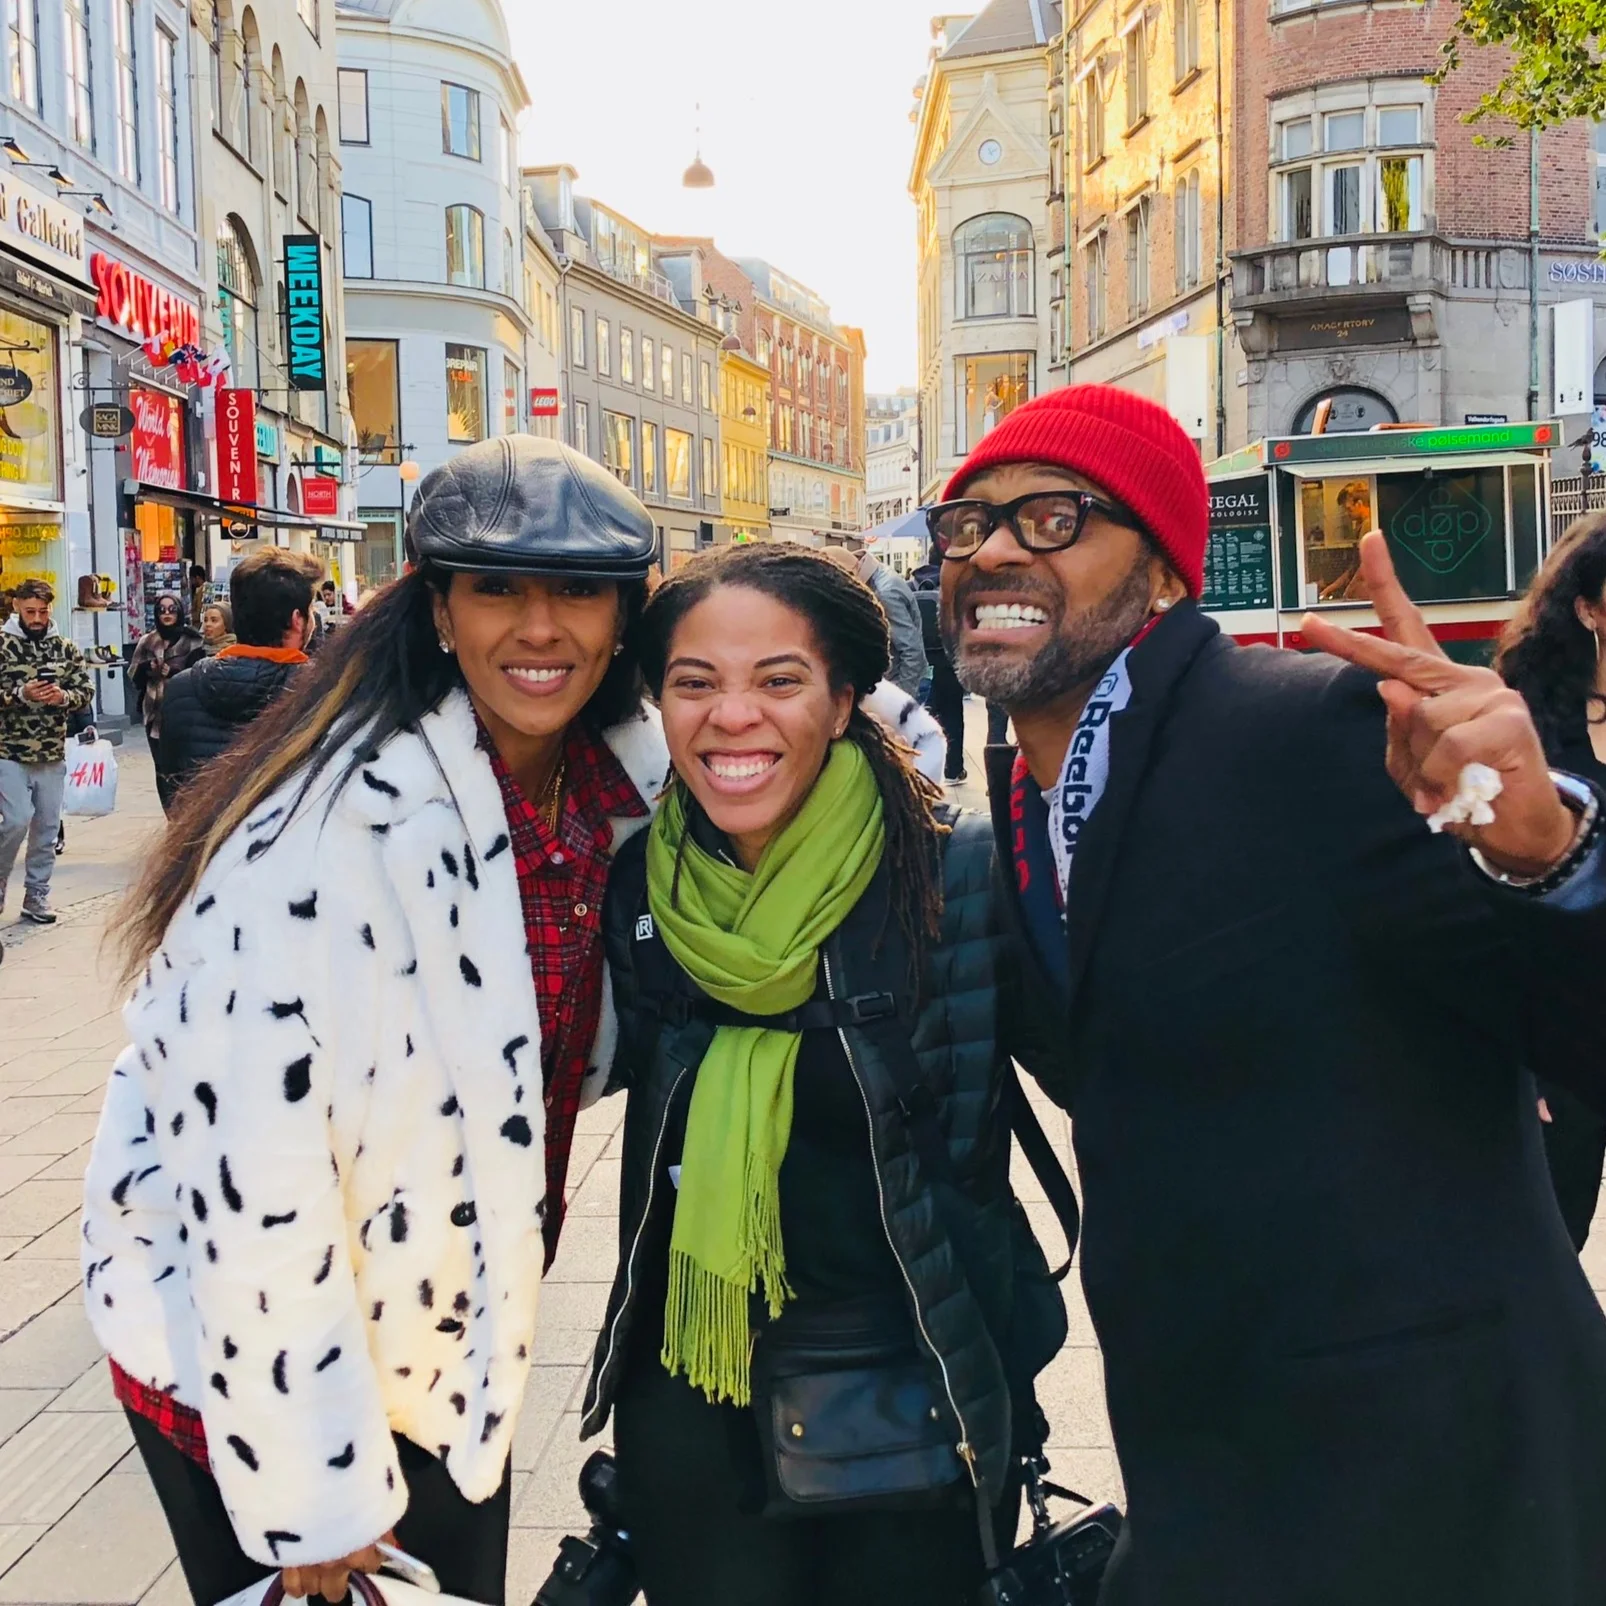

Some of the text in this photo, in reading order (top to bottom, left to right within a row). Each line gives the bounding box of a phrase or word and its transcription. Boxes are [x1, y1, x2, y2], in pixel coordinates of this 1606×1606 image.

[17, 195, 82, 261] Galleriet
[90, 252, 200, 350] SOUVENIR
[287, 245, 322, 379] WEEKDAY
[534, 396, 556, 407] LEGO
[96, 411, 118, 421] SAGA
[96, 422, 119, 432] MINK
[226, 392, 241, 501] SOUVENIR
[1427, 429, 1511, 448] pølsemand
[1206, 494, 1260, 510] NEGAL
[1207, 509, 1260, 518] KOLOGISK
[69, 762, 105, 788] H&M
